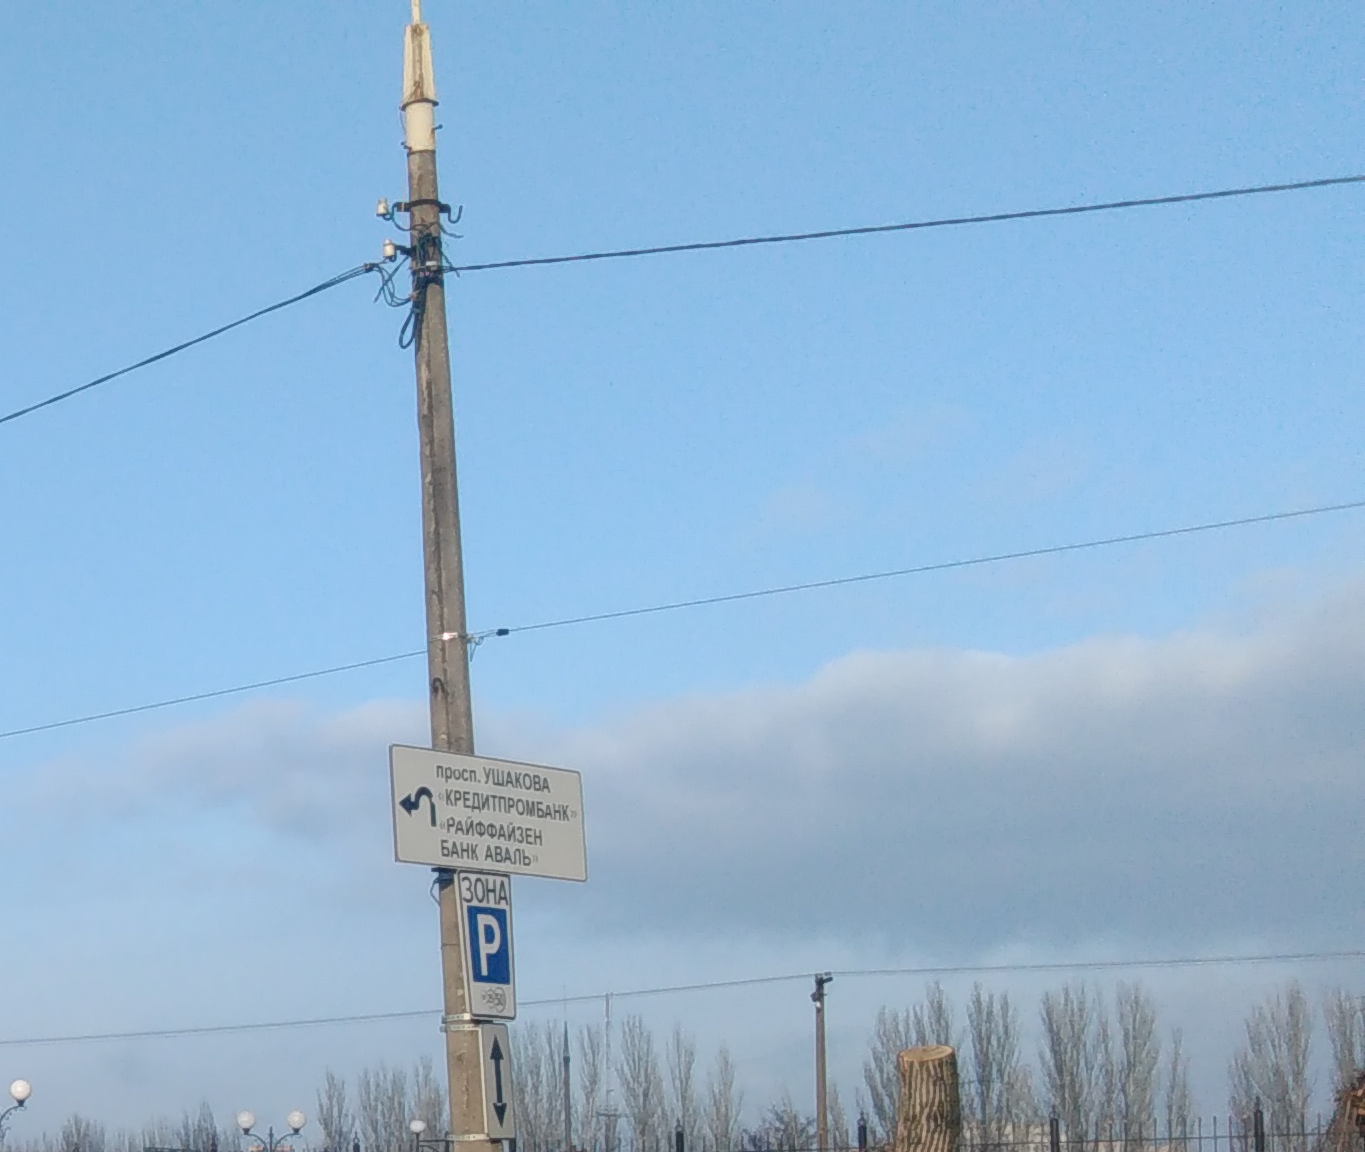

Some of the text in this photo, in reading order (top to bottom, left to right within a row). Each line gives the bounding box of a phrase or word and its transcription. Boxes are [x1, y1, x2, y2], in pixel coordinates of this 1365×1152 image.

[435, 764, 552, 794] просп. УШАКОВА
[437, 788, 578, 823] «КРЕДИТПРОМБАНК»
[439, 816, 544, 847] «РАЙФФАЙЗЕН
[440, 839, 540, 868] БАНК АВАЛЬ»
[460, 876, 510, 906] ЗОНА
[476, 913, 501, 977] P
